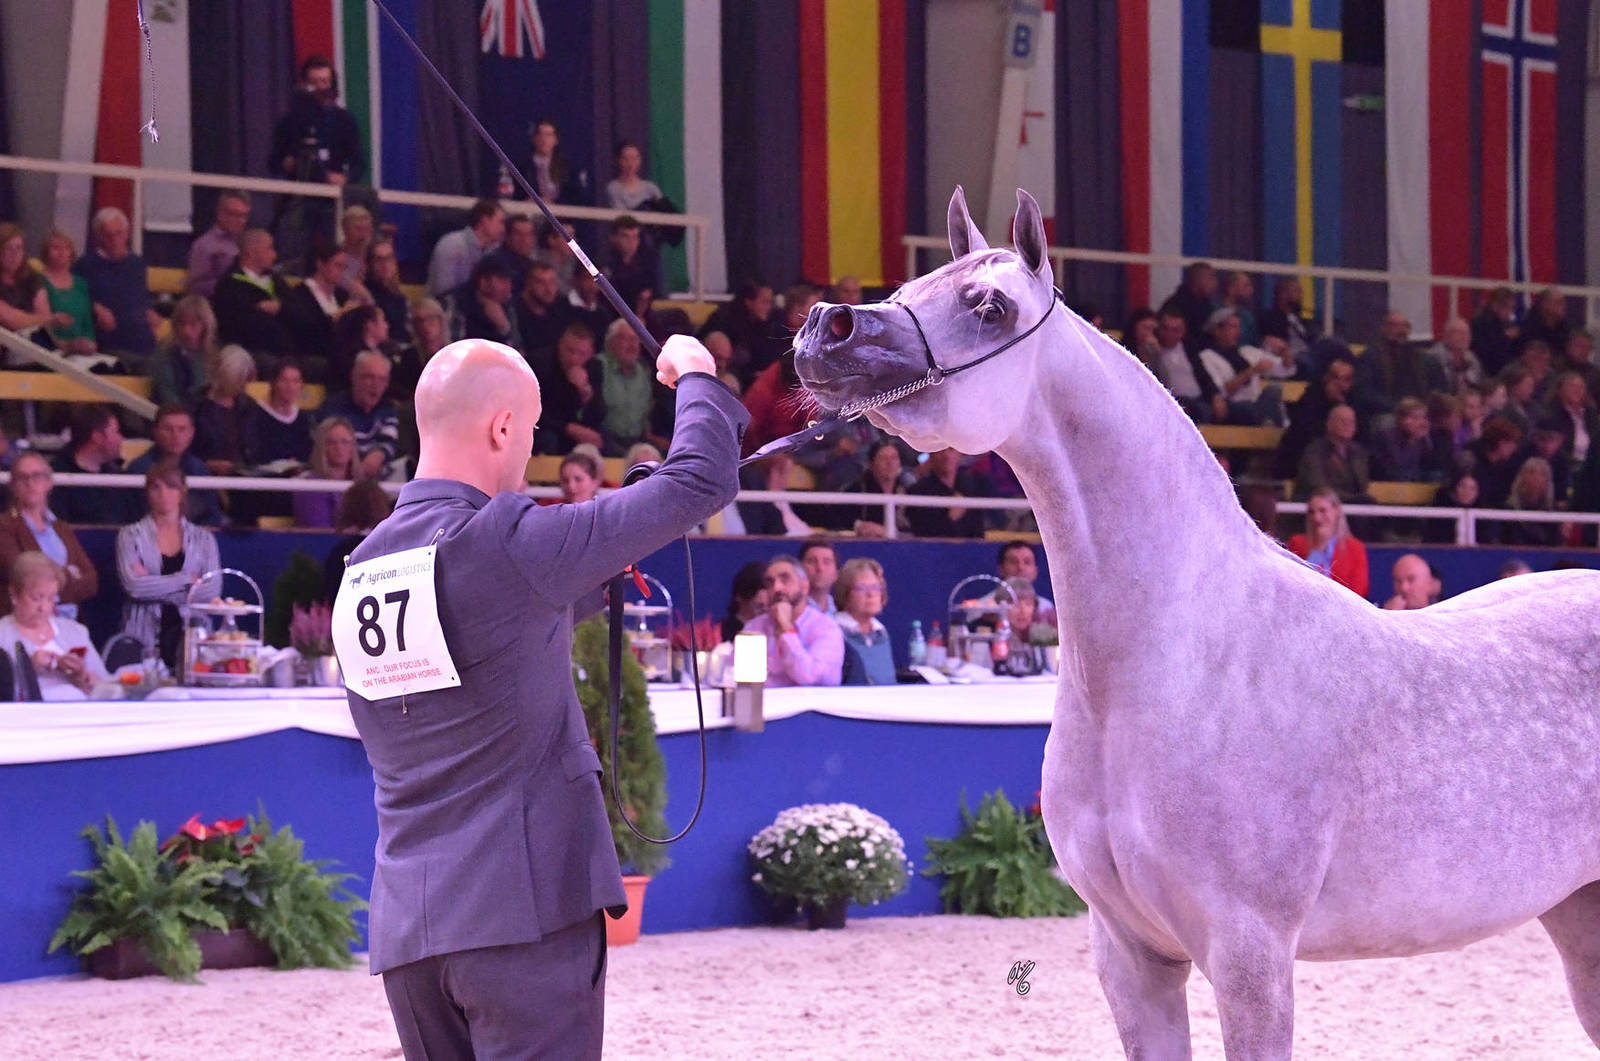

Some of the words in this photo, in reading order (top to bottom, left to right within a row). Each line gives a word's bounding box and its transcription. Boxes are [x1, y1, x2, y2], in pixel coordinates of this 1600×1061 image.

[1013, 24, 1031, 57] B
[356, 589, 410, 658] 87
[362, 679, 373, 688] ON
[373, 676, 388, 686] THE
[388, 671, 417, 683] ARABIAN
[417, 667, 441, 678] HORSE
[384, 663, 398, 672] OUR
[398, 659, 421, 670] FOCUS
[422, 658, 430, 667] IS
